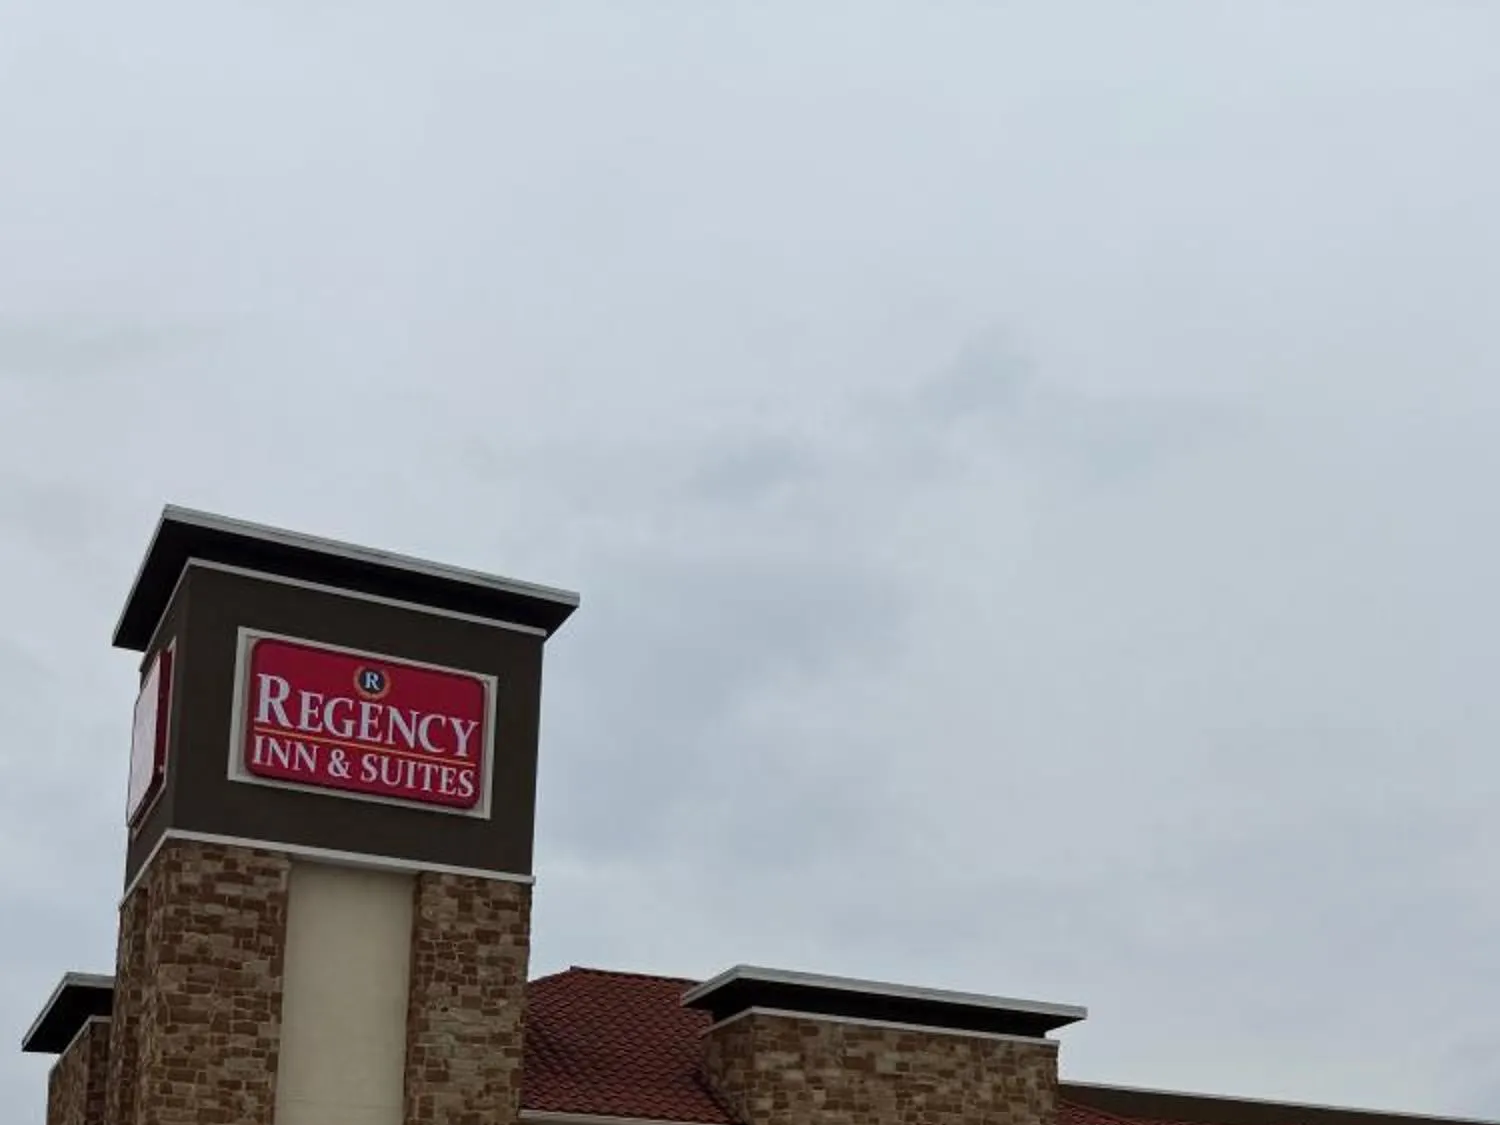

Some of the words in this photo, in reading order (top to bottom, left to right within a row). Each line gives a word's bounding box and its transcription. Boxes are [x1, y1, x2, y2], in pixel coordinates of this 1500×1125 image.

[364, 671, 381, 692] R
[254, 673, 480, 757] REGENCY
[252, 735, 320, 773] INN
[327, 749, 352, 779] &
[361, 753, 475, 797] SUITES
